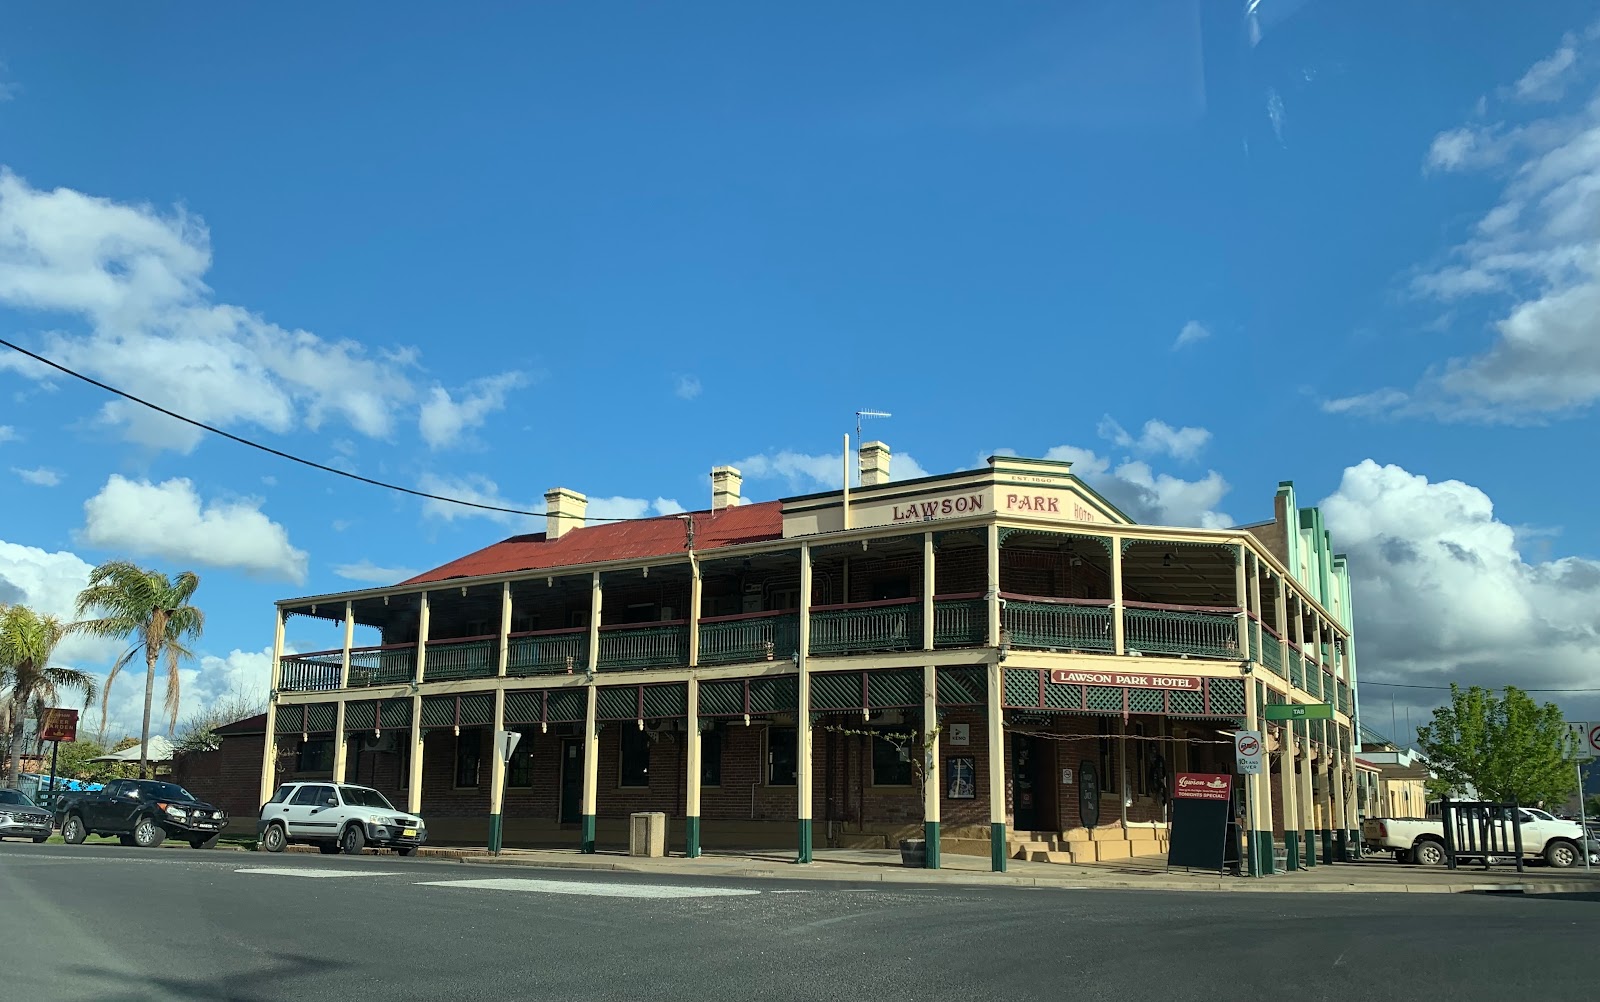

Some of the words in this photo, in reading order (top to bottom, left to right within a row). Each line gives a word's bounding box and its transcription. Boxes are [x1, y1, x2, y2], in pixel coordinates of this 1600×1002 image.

[893, 494, 984, 521] LAWSON
[1006, 493, 1060, 513] PARK
[1060, 672, 1112, 684] LAWSON
[1116, 675, 1148, 686] PARK
[1152, 677, 1192, 688] HOTEL
